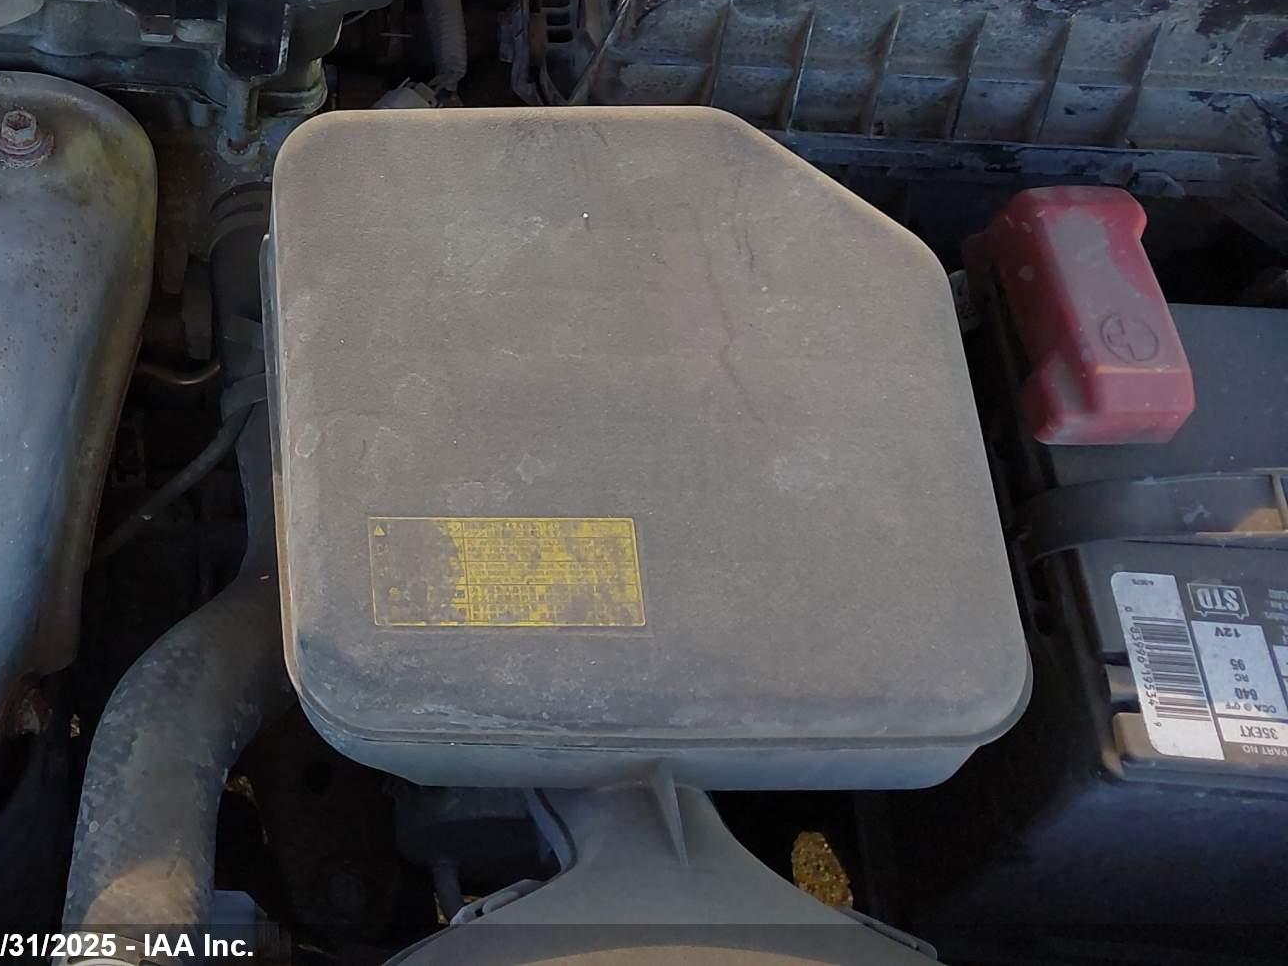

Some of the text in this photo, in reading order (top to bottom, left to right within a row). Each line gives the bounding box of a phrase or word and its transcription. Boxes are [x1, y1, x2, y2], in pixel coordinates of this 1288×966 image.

[1196, 588, 1241, 612] STD
[1214, 627, 1241, 638] 12V
[1229, 658, 1246, 671] 95
[1234, 673, 1250, 683] RC
[1234, 687, 1258, 701] 640
[1255, 704, 1278, 714] CCA
[1240, 724, 1279, 740] 35EXT
[1262, 747, 1288, 758] PART
